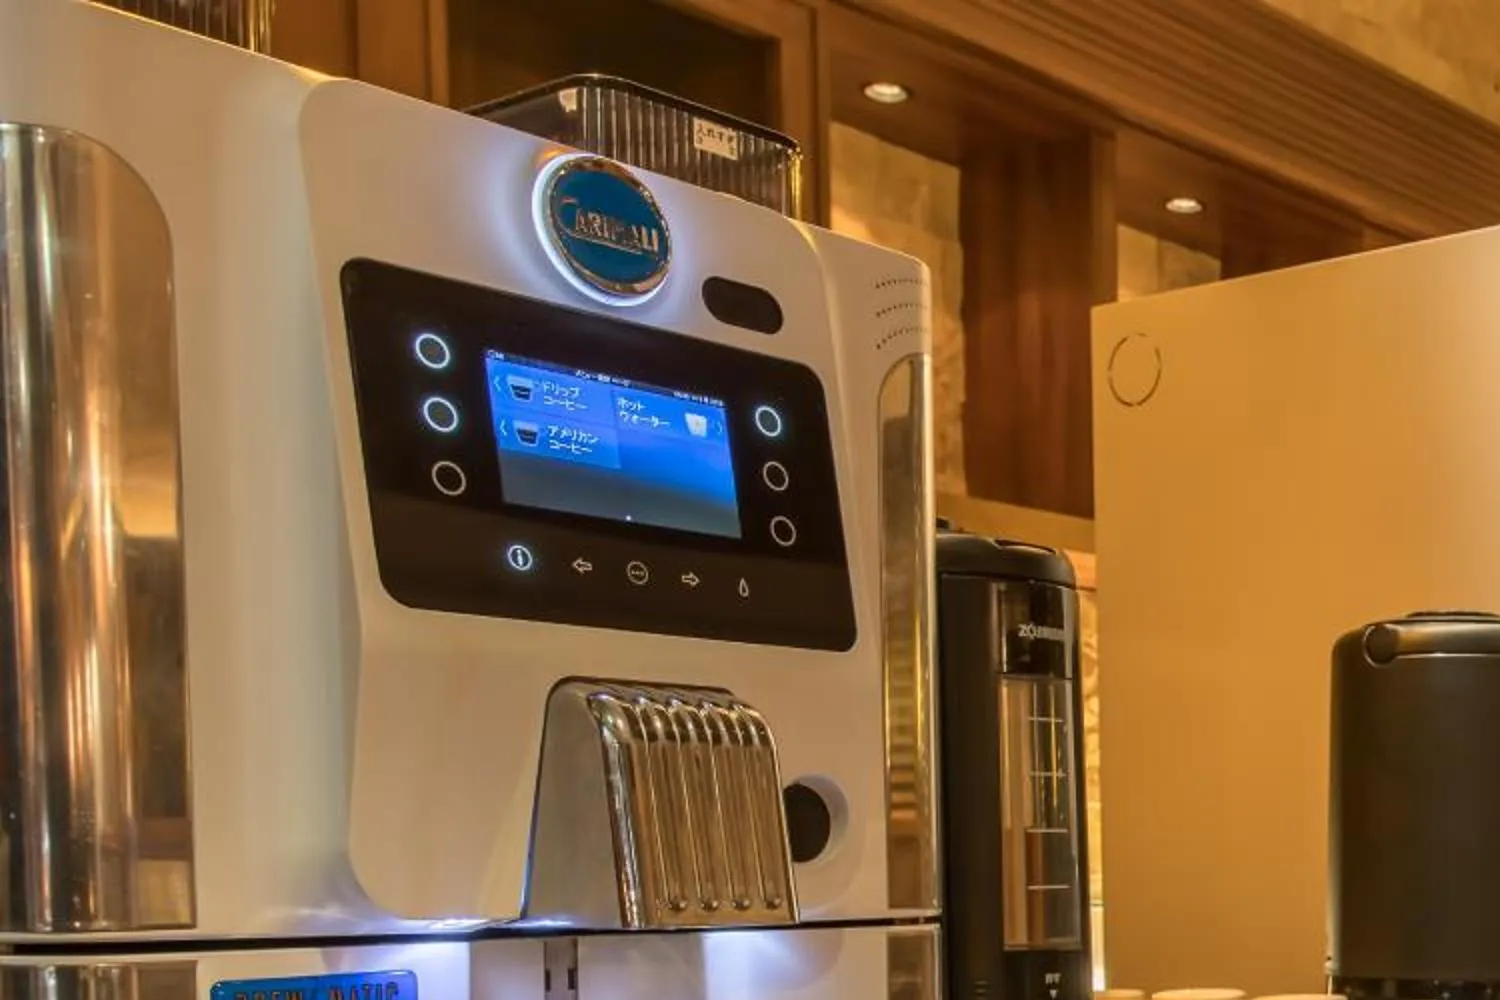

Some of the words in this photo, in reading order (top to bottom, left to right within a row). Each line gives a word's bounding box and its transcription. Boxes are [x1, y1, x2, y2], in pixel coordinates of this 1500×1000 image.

[543, 396, 589, 411] コーヒー
[549, 439, 593, 454] コーヒー
